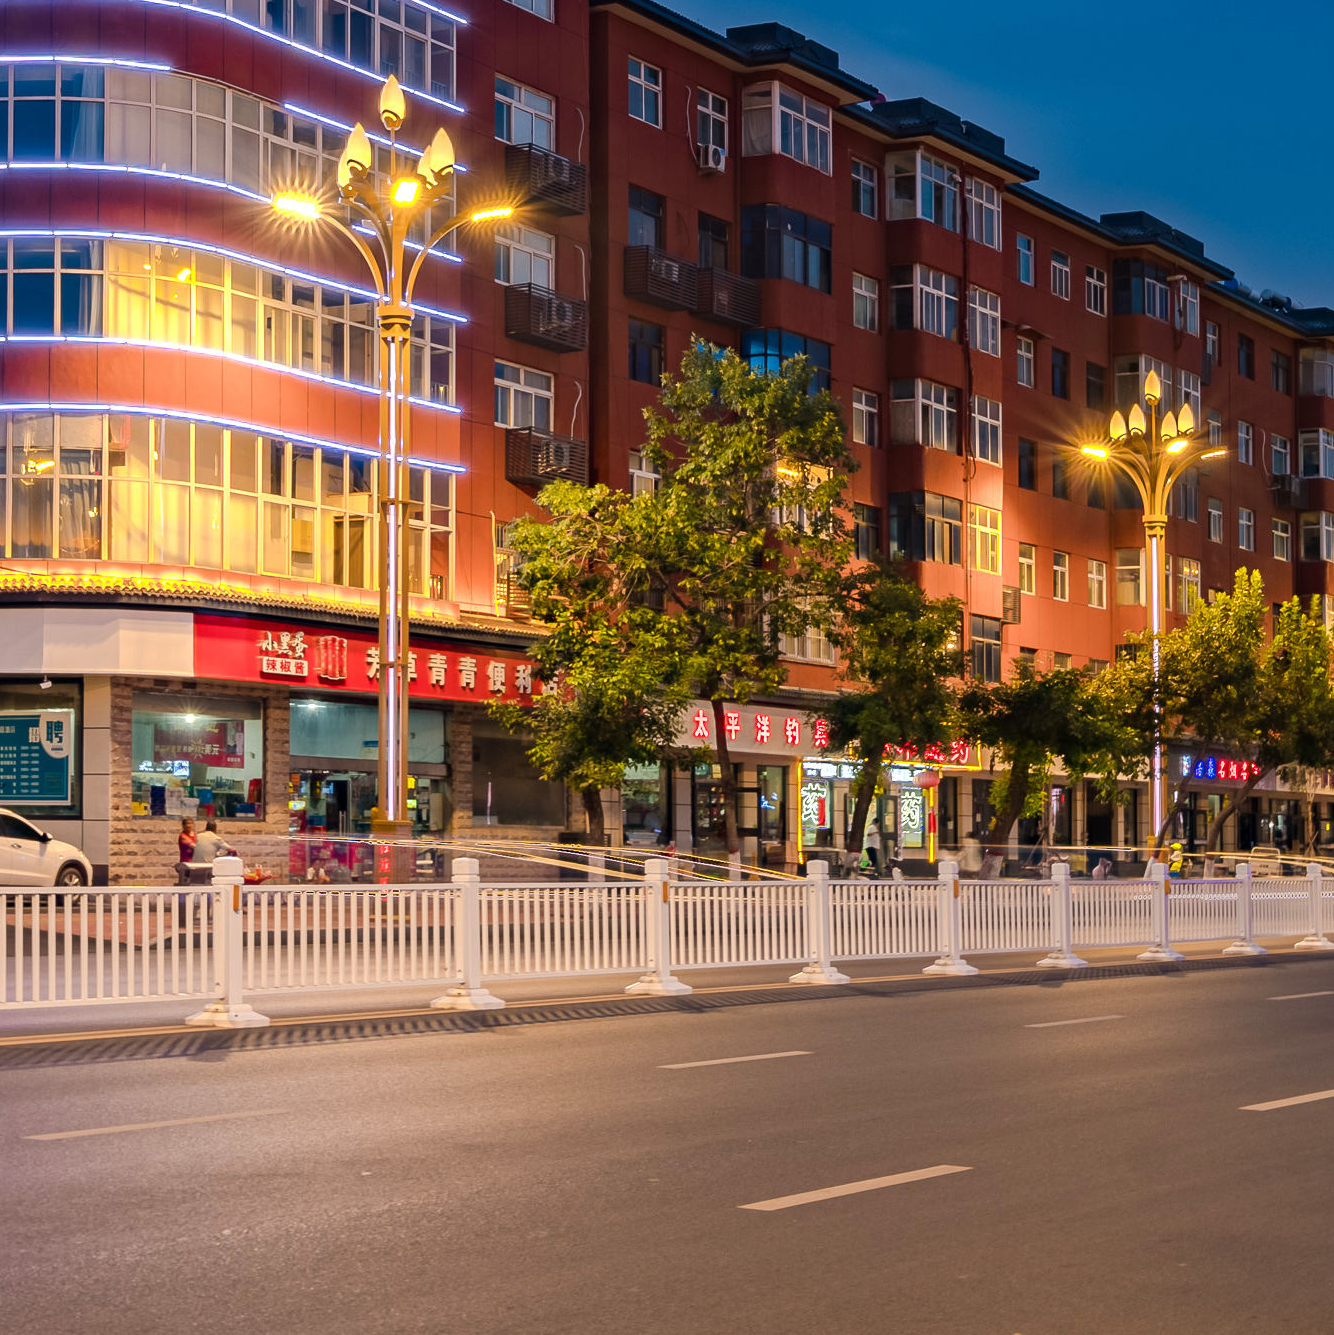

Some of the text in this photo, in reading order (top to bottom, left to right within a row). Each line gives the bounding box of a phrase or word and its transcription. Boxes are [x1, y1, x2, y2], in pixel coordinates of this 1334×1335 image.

[265, 658, 305, 675] 辣椒酱
[693, 709, 829, 747] 太平洋钓具
[900, 791, 922, 829] 药
